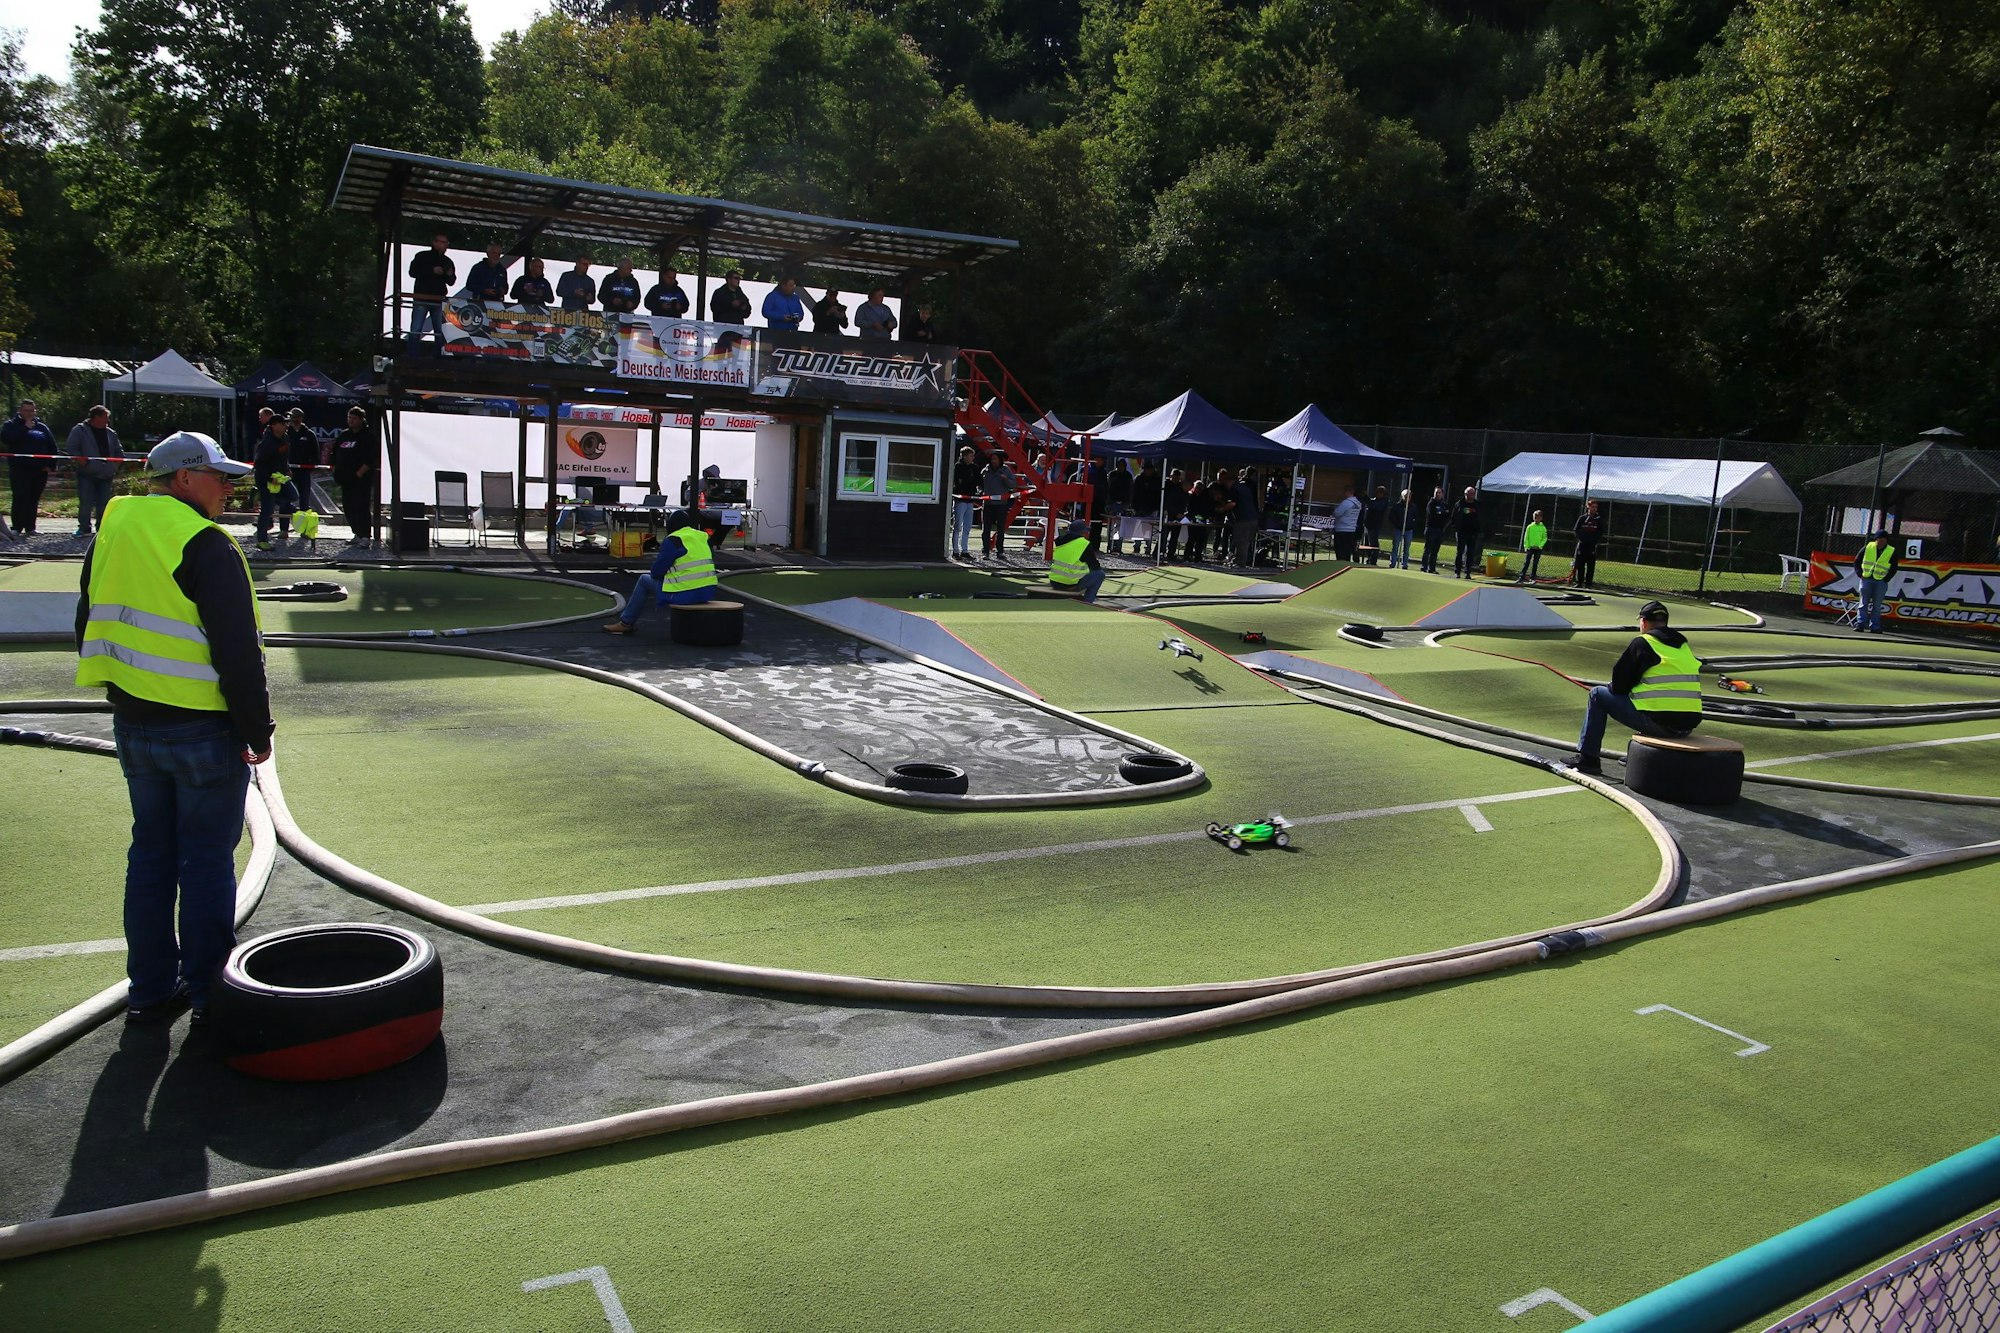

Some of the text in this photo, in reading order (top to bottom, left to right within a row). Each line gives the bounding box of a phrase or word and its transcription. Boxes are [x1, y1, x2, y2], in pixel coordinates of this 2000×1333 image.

[487, 309, 548, 323] Modellautoclub
[550, 309, 577, 326] Eifel
[579, 312, 603, 328] Elos
[673, 328, 699, 340] DMC
[772, 348, 925, 383] TONISPORT
[622, 359, 744, 385] Deutsche Meisterschaft
[267, 394, 301, 402] 24MX
[328, 397, 361, 405] 24MX
[622, 411, 663, 424] HOBBI
[182, 454, 203, 466] staff
[572, 464, 592, 472] Eifel
[594, 465, 612, 473] Elos
[613, 466, 630, 474] e.V.
[1908, 545, 1917, 556] 6
[1811, 595, 1890, 613] WORD
